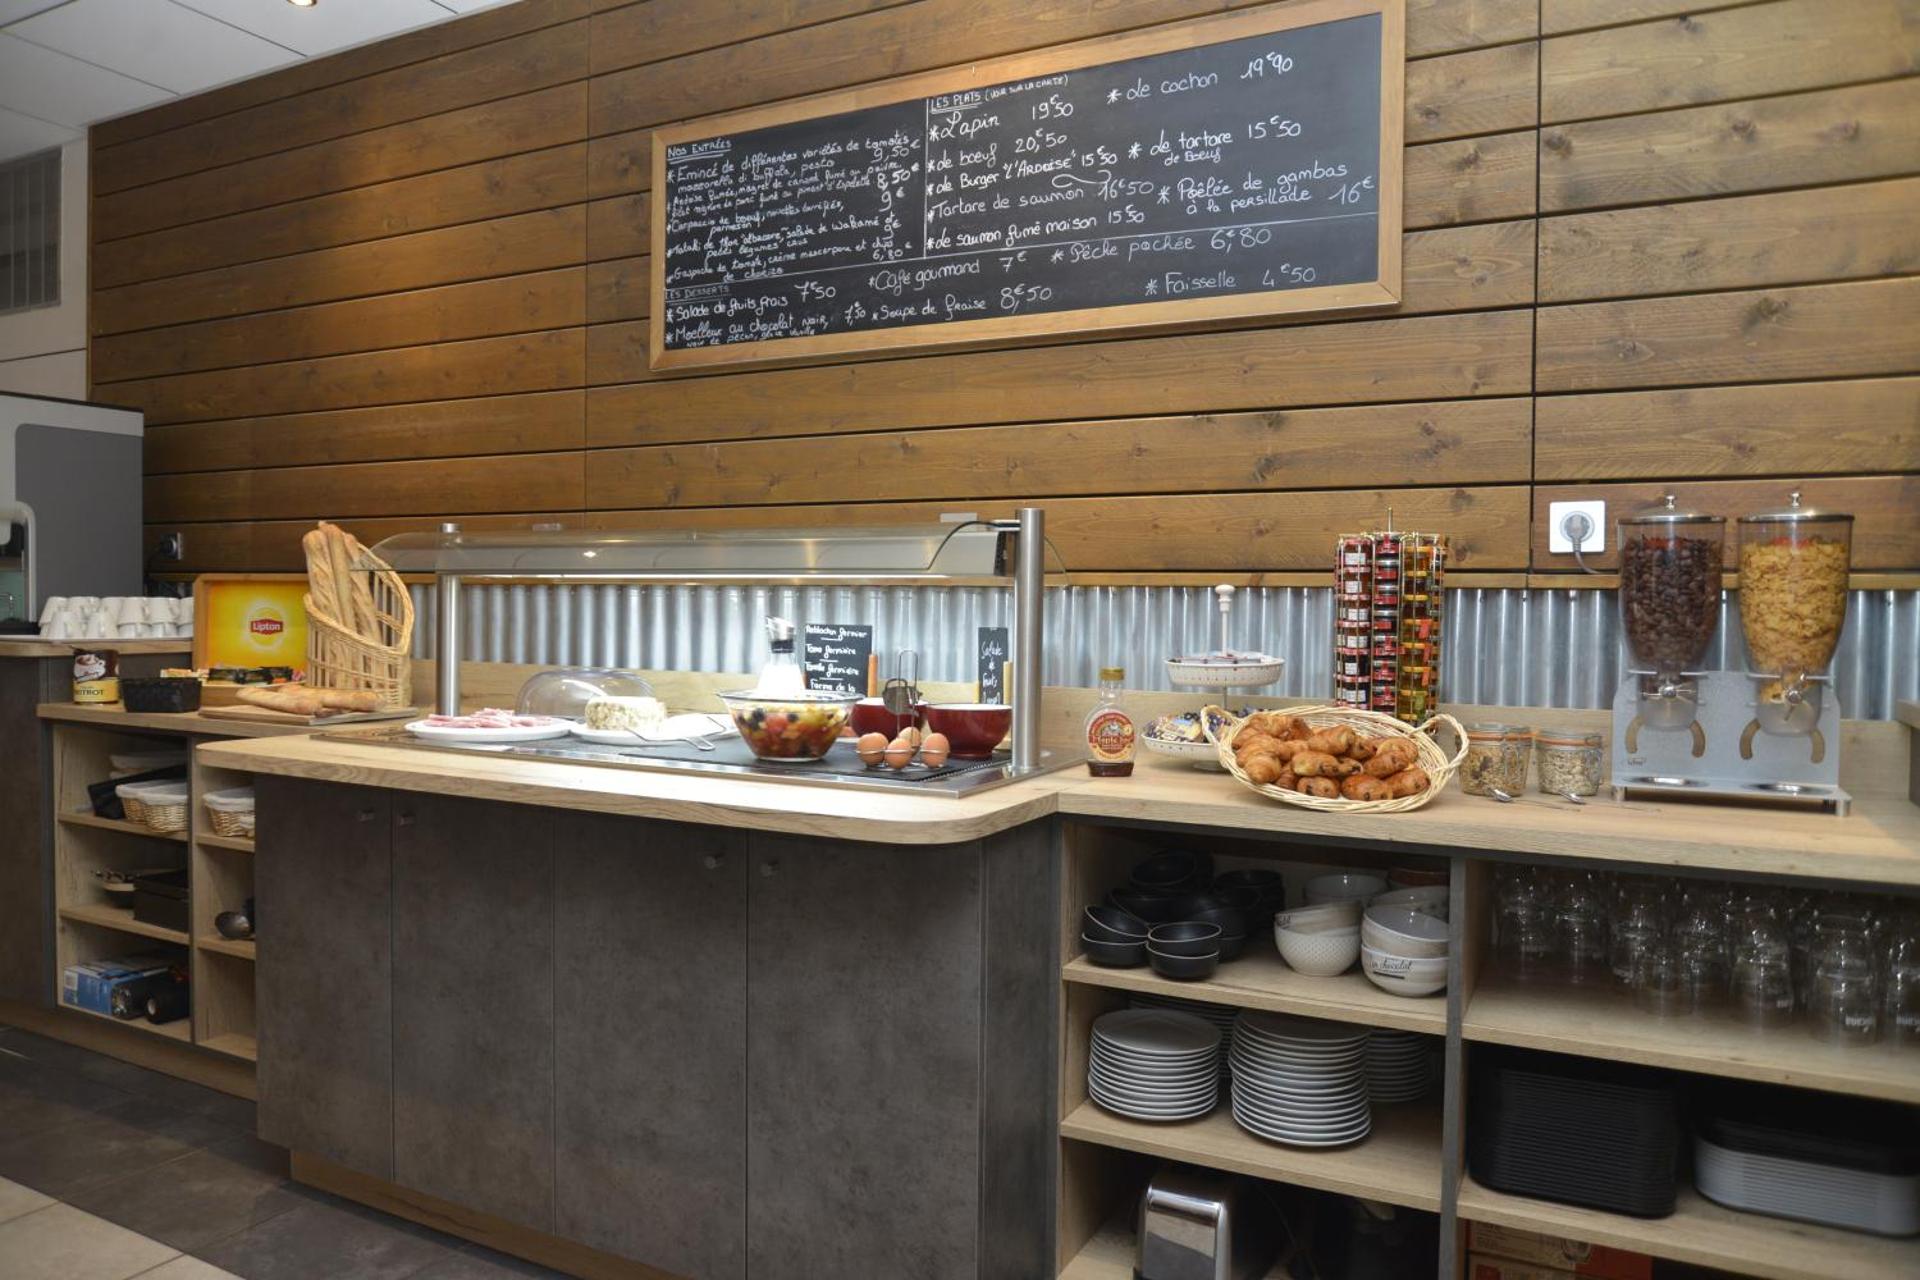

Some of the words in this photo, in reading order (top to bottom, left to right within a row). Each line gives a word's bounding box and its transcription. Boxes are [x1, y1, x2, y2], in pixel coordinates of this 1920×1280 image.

[953, 92, 981, 105] PLATS
[1126, 78, 1151, 101] de
[1160, 71, 1219, 95] cochon
[940, 110, 1000, 139] Lapin
[1150, 129, 1171, 156] de
[1178, 131, 1234, 149] tartare
[722, 159, 735, 173] de
[846, 140, 860, 151] de
[937, 149, 953, 170] de
[1164, 153, 1180, 166] de
[936, 174, 954, 192] de
[960, 172, 1000, 190] Burger
[1177, 175, 1233, 202] Poêlée
[1243, 172, 1263, 190] de
[1277, 160, 1348, 194] gambas
[931, 199, 987, 218] Tartare
[993, 195, 1010, 209] de
[1018, 188, 1084, 208] saumon
[1206, 196, 1221, 213] la
[1230, 188, 1312, 214] persillade
[935, 228, 952, 249] de
[956, 231, 1002, 247] saumon
[1005, 222, 1041, 247] fumé
[1045, 216, 1097, 233] maison
[915, 259, 980, 291] gourmand
[1165, 270, 1237, 295] Faisselle
[749, 312, 794, 332] chocolat
[879, 304, 918, 322] Soupe
[921, 299, 937, 315] de
[252, 621, 282, 633] Lipton
